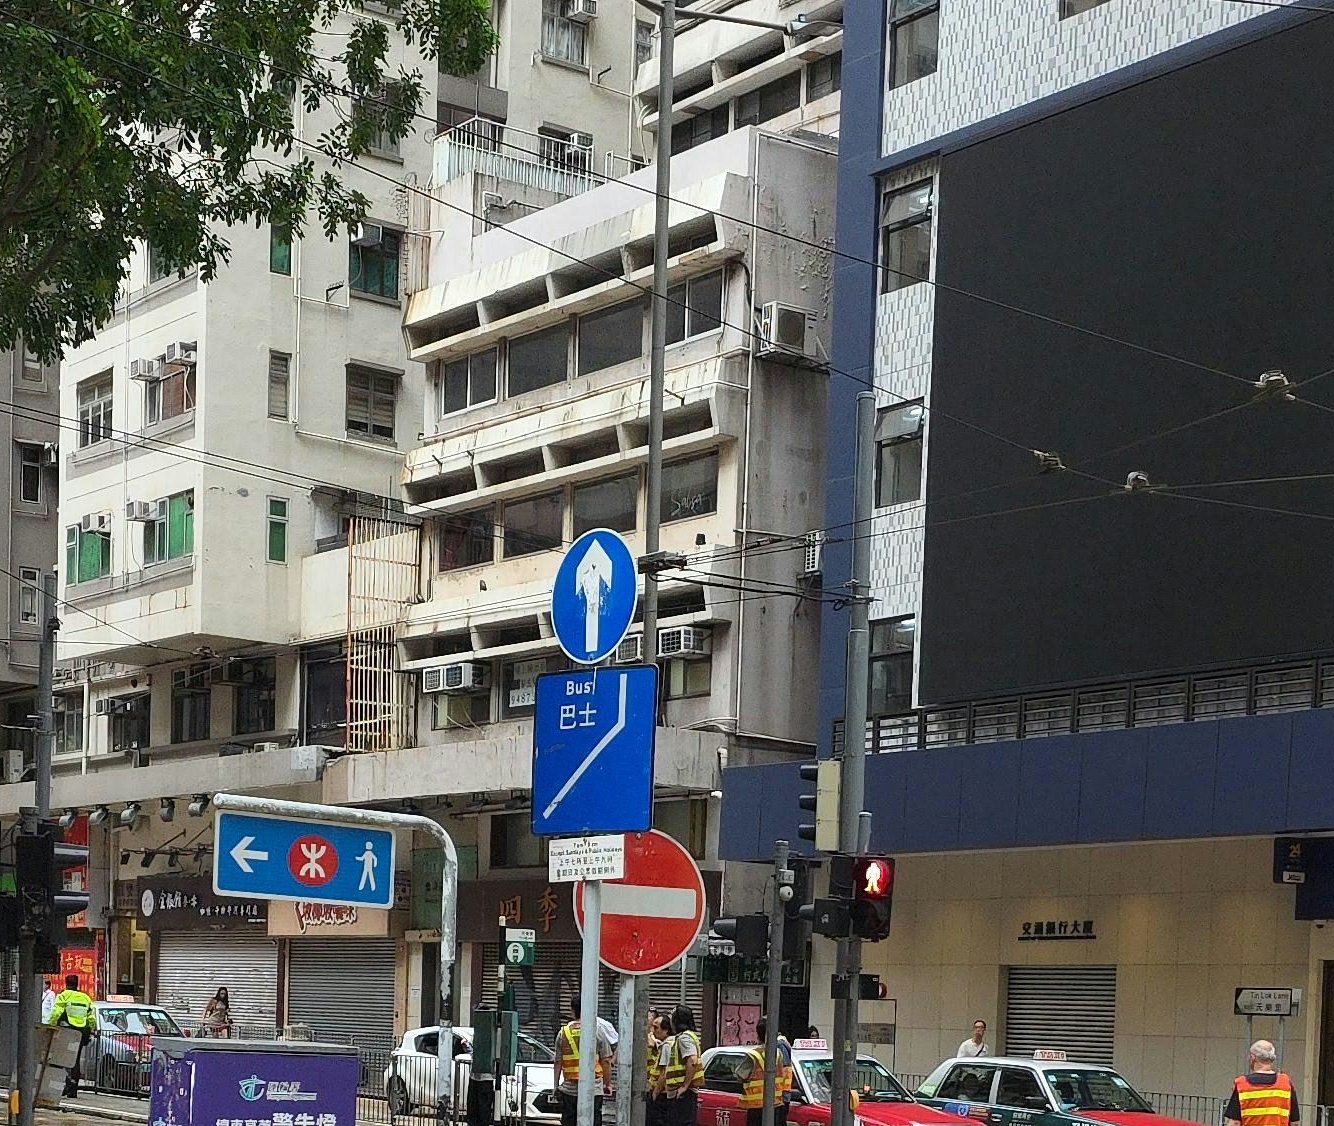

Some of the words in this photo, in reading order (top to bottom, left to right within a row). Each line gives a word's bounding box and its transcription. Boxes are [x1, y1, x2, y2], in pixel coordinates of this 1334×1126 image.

[566, 680, 593, 696] Bus
[560, 702, 597, 730] 巴士
[499, 886, 558, 933] 四季
[1022, 920, 1094, 935] 交通銀行大廈
[1251, 991, 1260, 999] Tin
